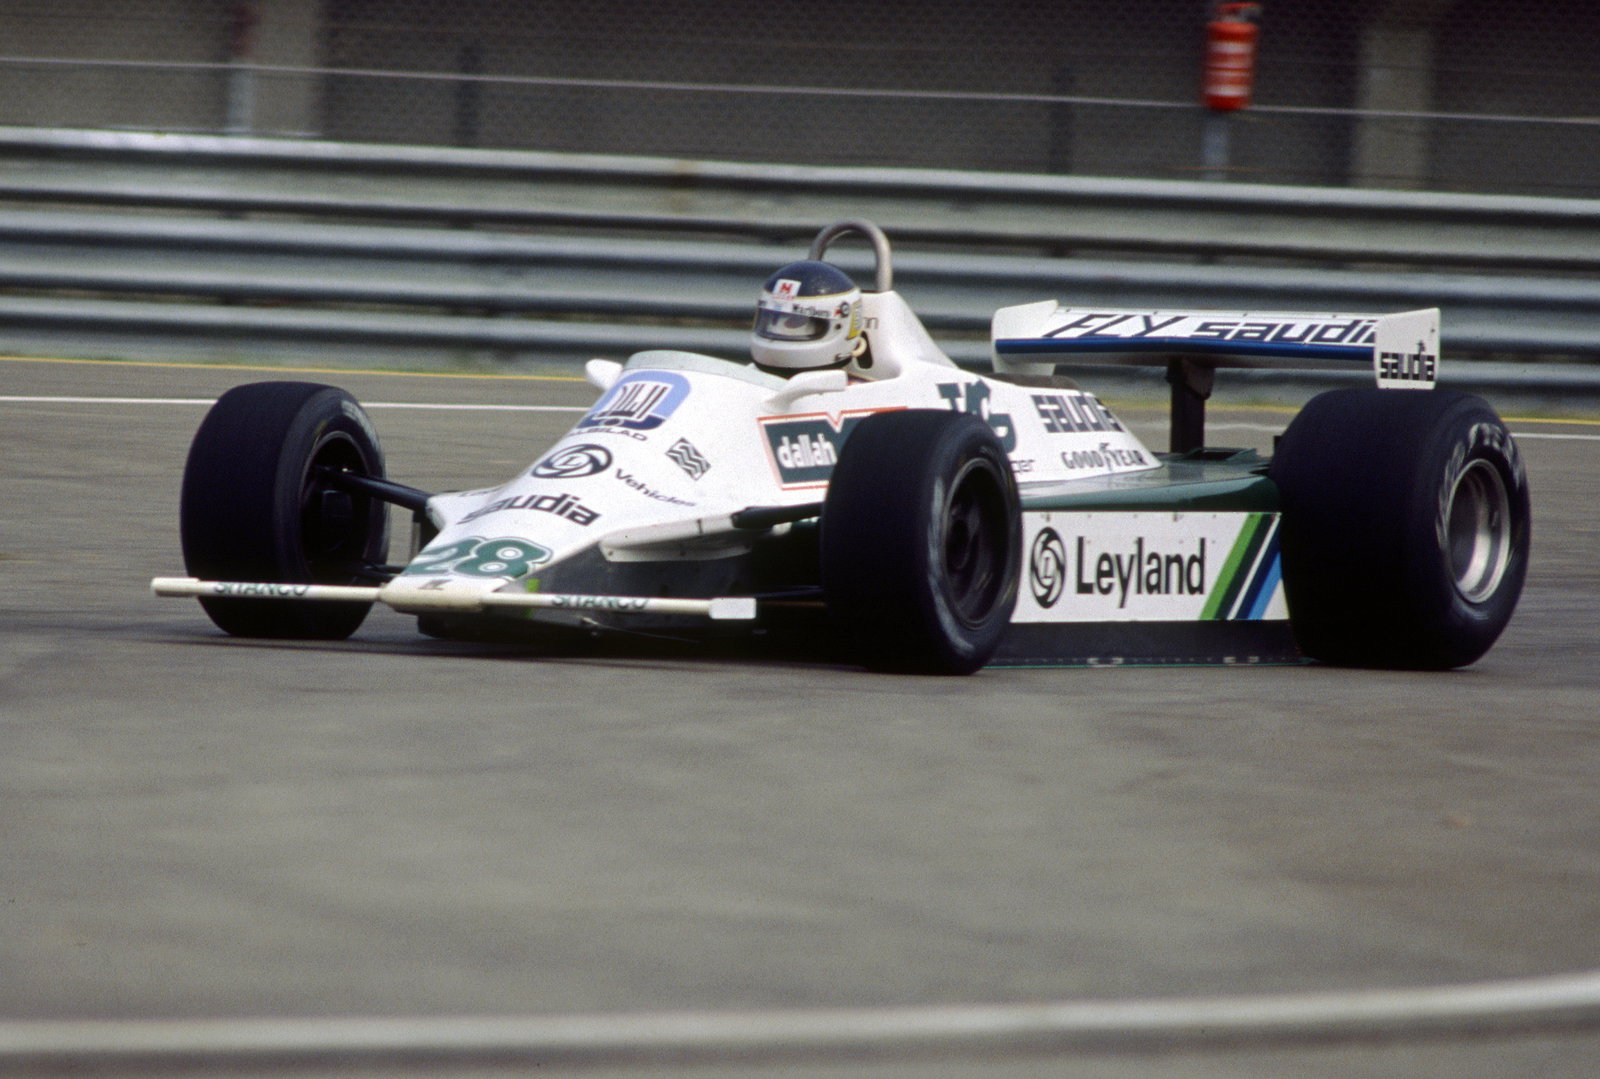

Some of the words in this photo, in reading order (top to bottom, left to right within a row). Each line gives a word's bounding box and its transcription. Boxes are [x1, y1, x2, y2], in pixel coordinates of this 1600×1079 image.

[1042, 314, 1189, 338] FLY
[777, 432, 838, 468] dallah
[615, 467, 698, 507] Vehicles
[456, 493, 601, 526] saudia
[401, 535, 553, 581] 28
[1076, 536, 1206, 609] Leyland
